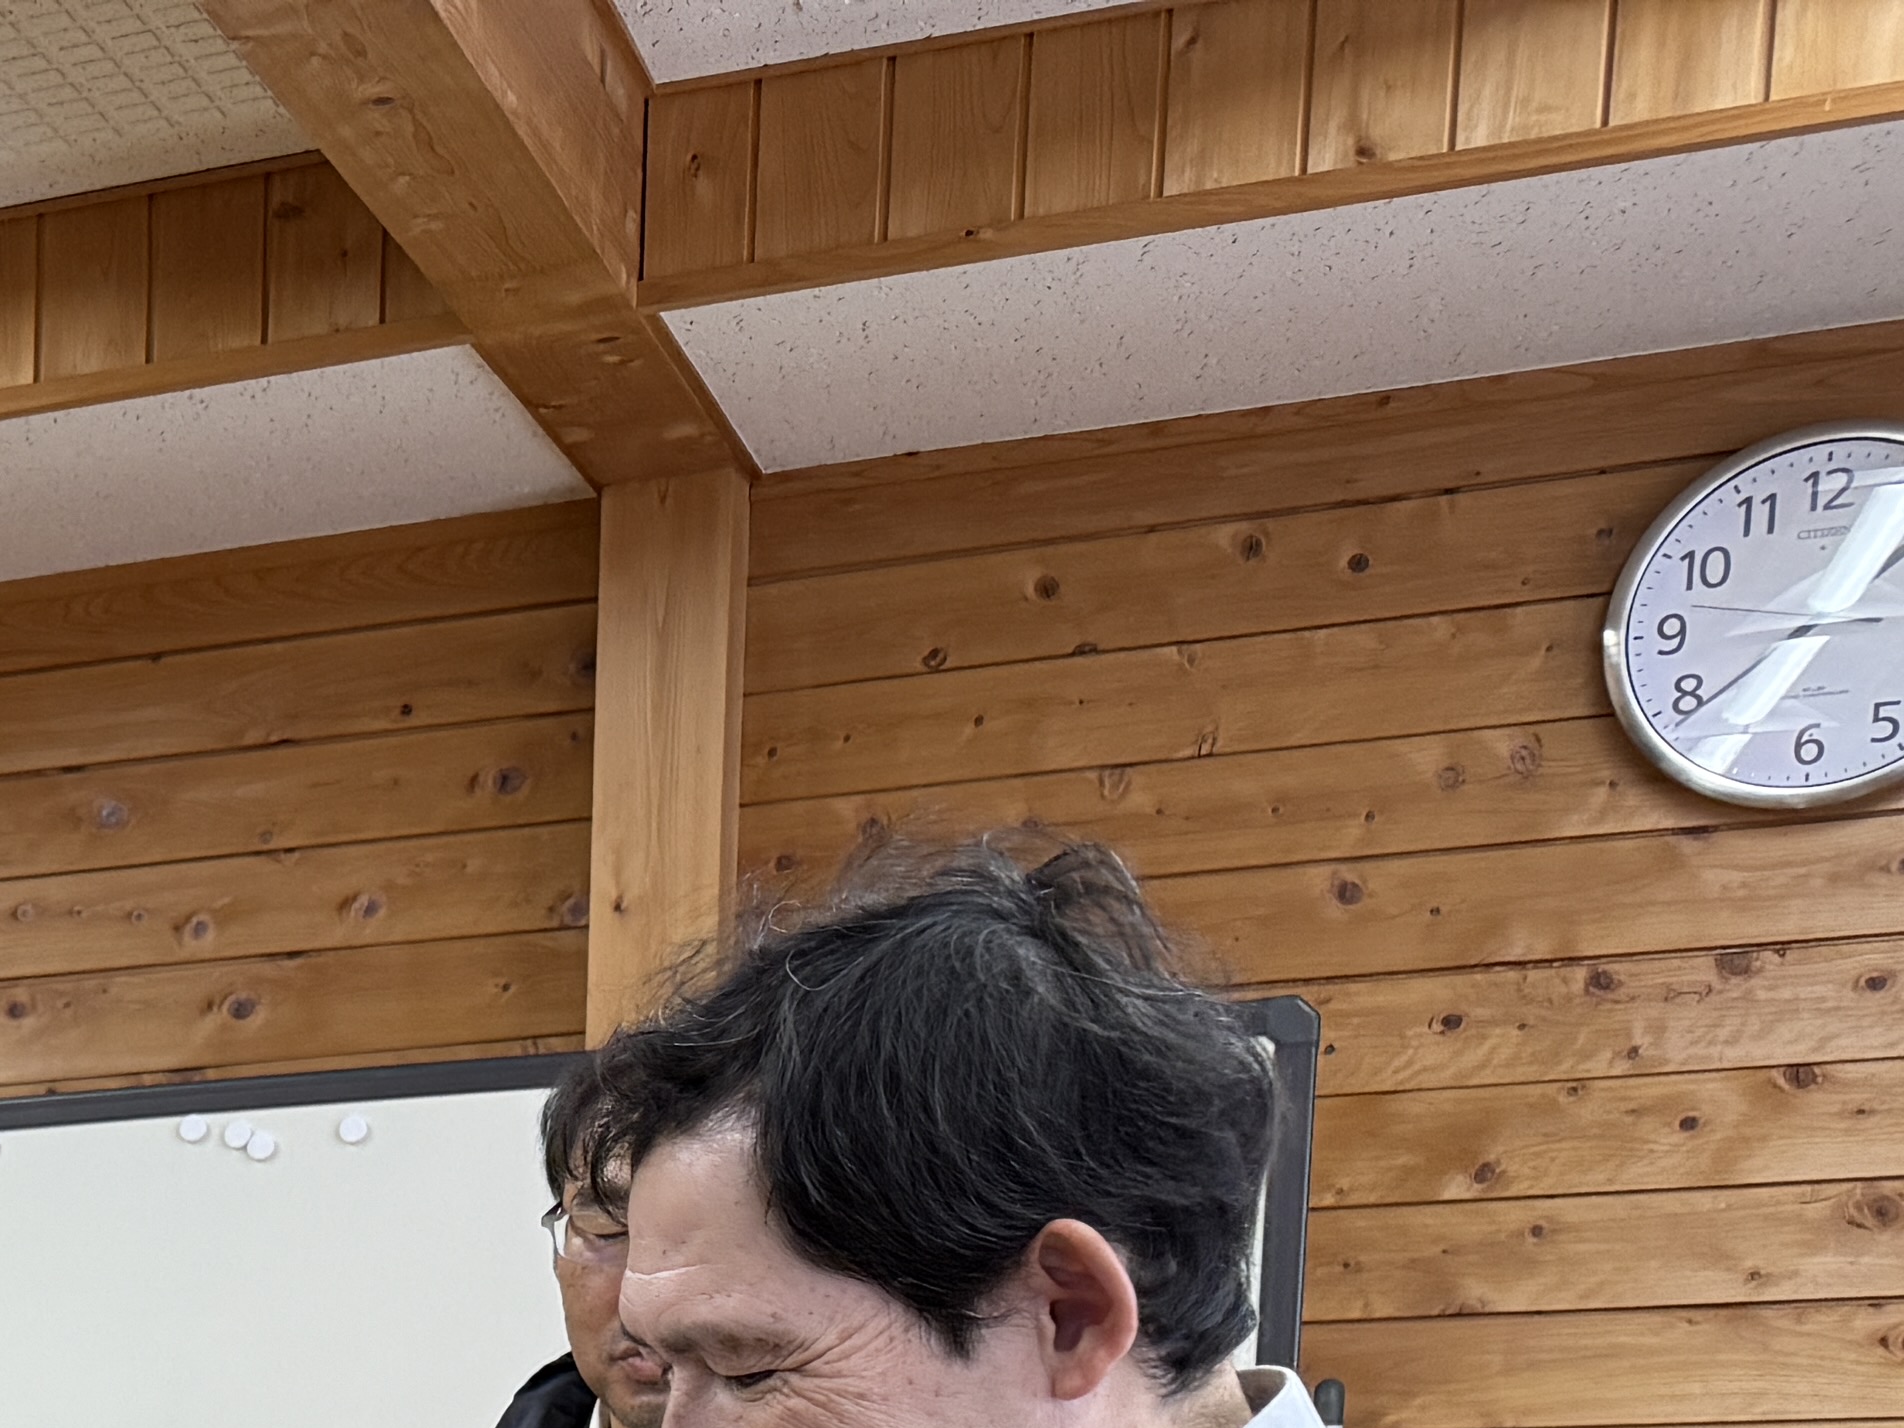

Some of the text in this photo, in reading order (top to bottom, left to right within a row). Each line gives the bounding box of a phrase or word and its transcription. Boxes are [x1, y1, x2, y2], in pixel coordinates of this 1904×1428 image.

[1802, 466, 1856, 512] 12
[1736, 492, 1779, 538] 11
[1679, 545, 1732, 591] 10
[1656, 613, 1688, 655] 9
[1671, 672, 1705, 717] 8
[1793, 722, 1825, 765] 6
[1870, 699, 1902, 743] 5
